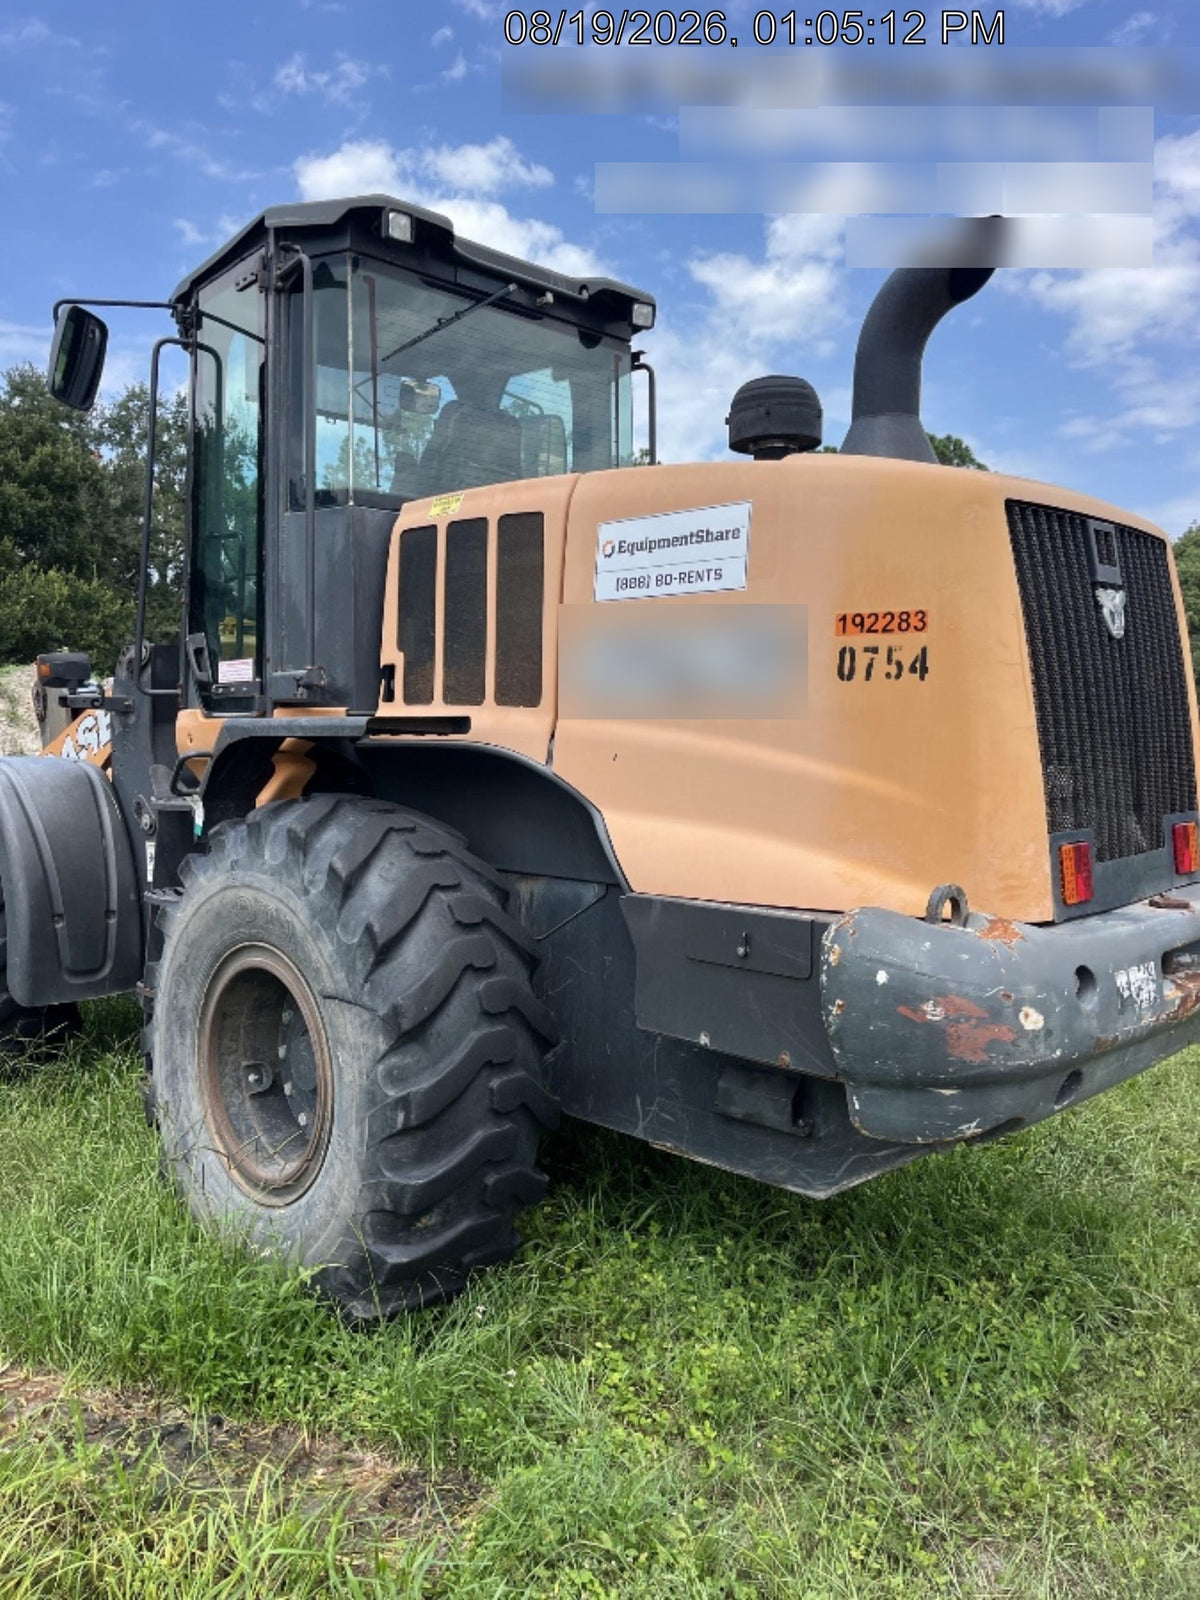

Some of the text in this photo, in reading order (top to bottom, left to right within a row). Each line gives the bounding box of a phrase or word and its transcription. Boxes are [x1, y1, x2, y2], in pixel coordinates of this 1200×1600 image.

[618, 528, 741, 555] EquipmentShare
[616, 568, 723, 592] (888) 80-RENTS
[838, 609, 927, 635] 192283
[837, 645, 929, 682] 0754
